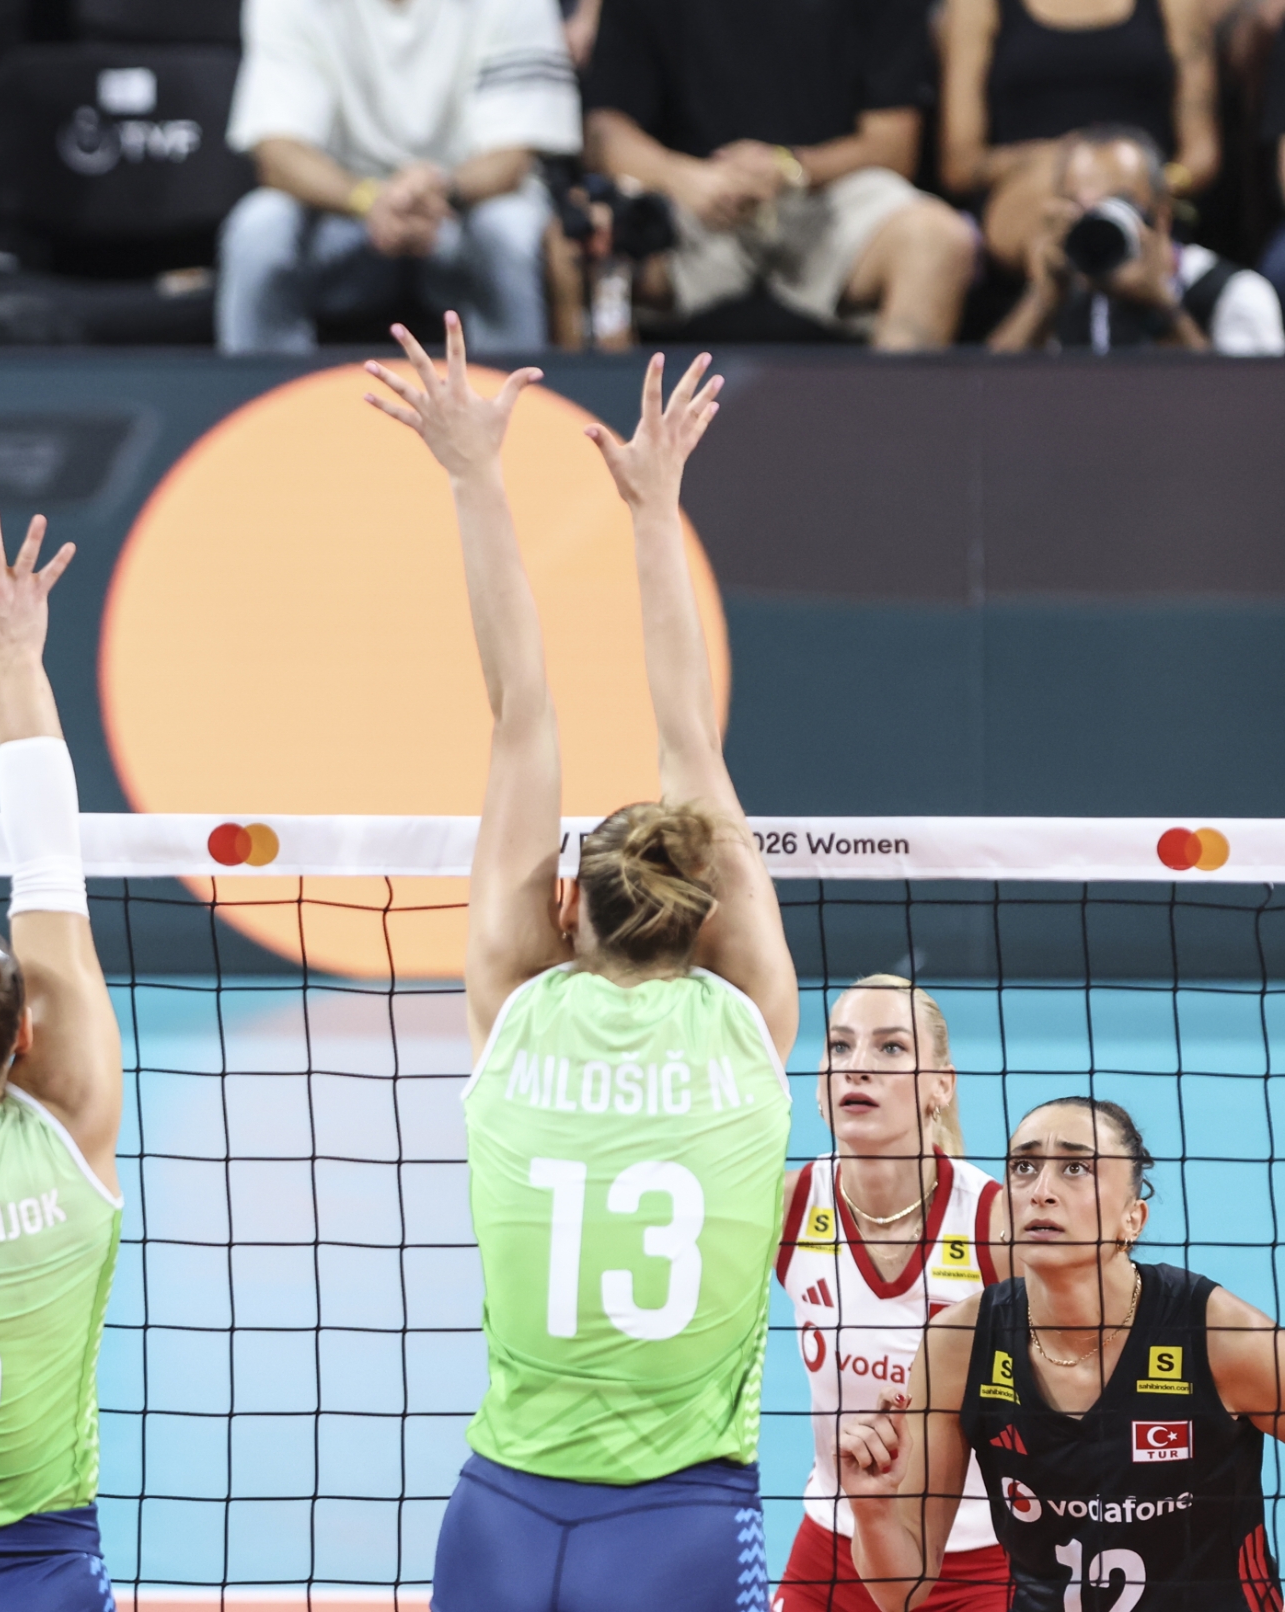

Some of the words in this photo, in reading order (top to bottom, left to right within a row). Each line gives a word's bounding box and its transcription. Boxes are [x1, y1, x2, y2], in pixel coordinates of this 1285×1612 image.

[806, 832, 910, 855] Women
[504, 1048, 692, 1116] MILOŠIČ
[708, 1056, 755, 1111] N.
[814, 1214, 830, 1233] S
[528, 1156, 705, 1341] 13
[949, 1240, 965, 1260] S
[835, 1350, 912, 1385] voda
[1156, 1352, 1175, 1372] S
[1147, 1450, 1178, 1459] TUR
[1047, 1492, 1194, 1523] vodafone
[1054, 1538, 1146, 1612] 12
